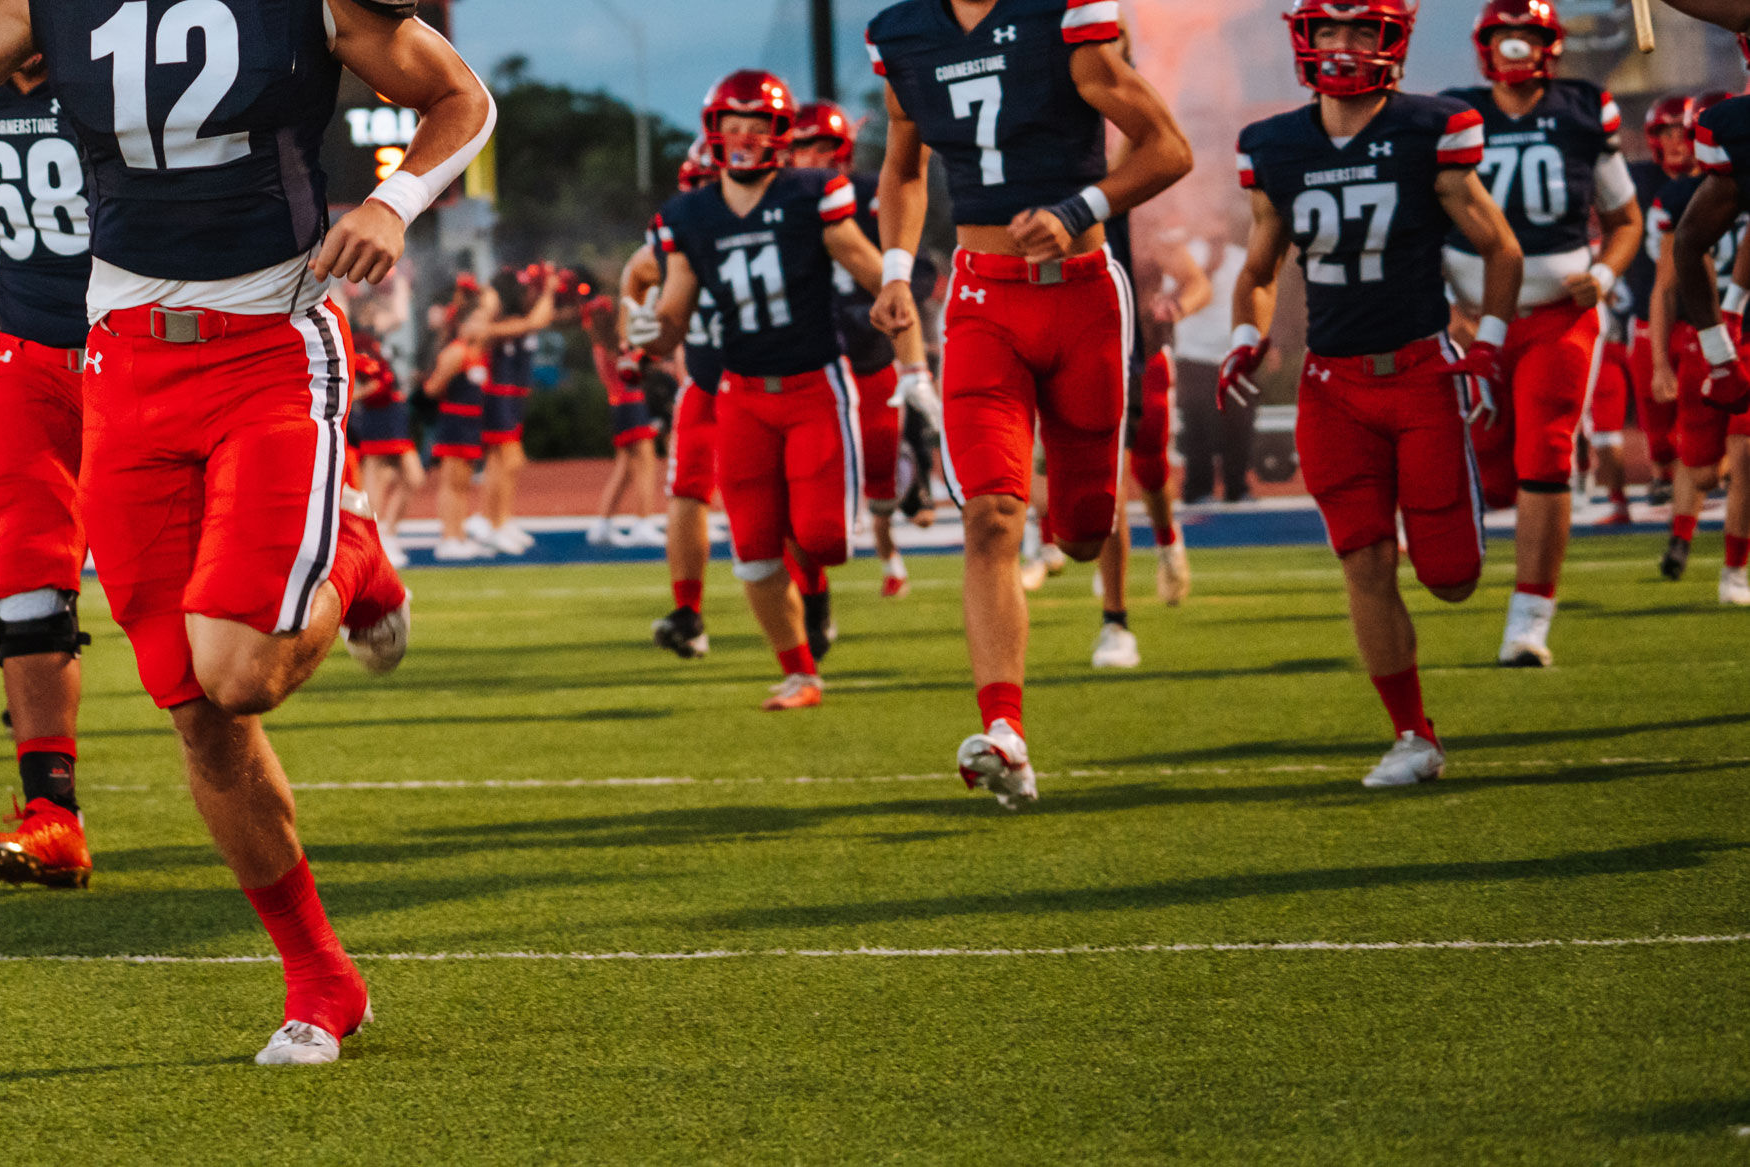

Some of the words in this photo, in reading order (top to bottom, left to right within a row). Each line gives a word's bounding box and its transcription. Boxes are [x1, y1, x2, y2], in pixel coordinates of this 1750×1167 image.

[948, 74, 1005, 186] 7
[1477, 144, 1567, 226] 70
[1293, 182, 1398, 285] 27
[718, 244, 791, 332] 11
